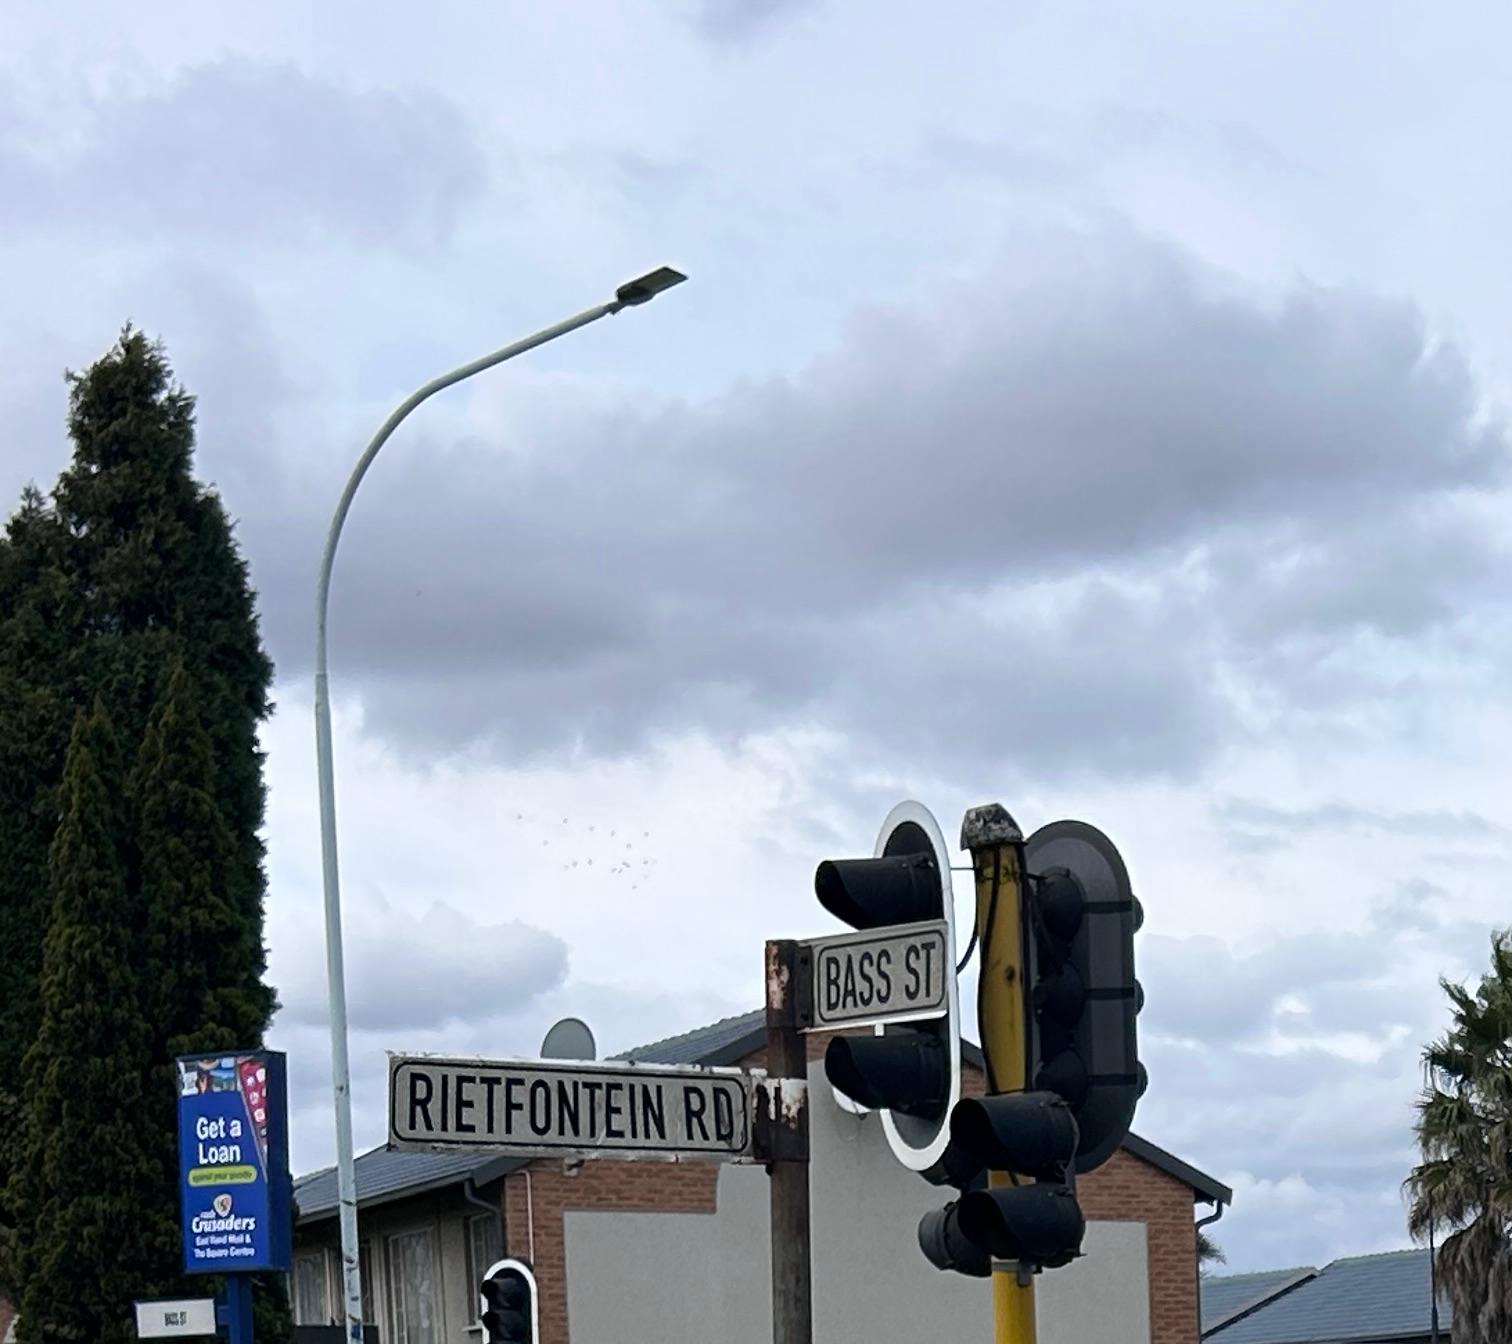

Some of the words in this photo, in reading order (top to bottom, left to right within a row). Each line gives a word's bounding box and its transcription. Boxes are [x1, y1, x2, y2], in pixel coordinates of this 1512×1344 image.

[826, 948, 892, 1012] BASS
[904, 941, 936, 1000] ST
[408, 1071, 667, 1140] RIETFONTEIN
[683, 1085, 735, 1143] RD
[196, 1116, 226, 1140] Get
[229, 1119, 242, 1138] a
[198, 1142, 241, 1165] Loan
[191, 1214, 256, 1234] Crusaders
